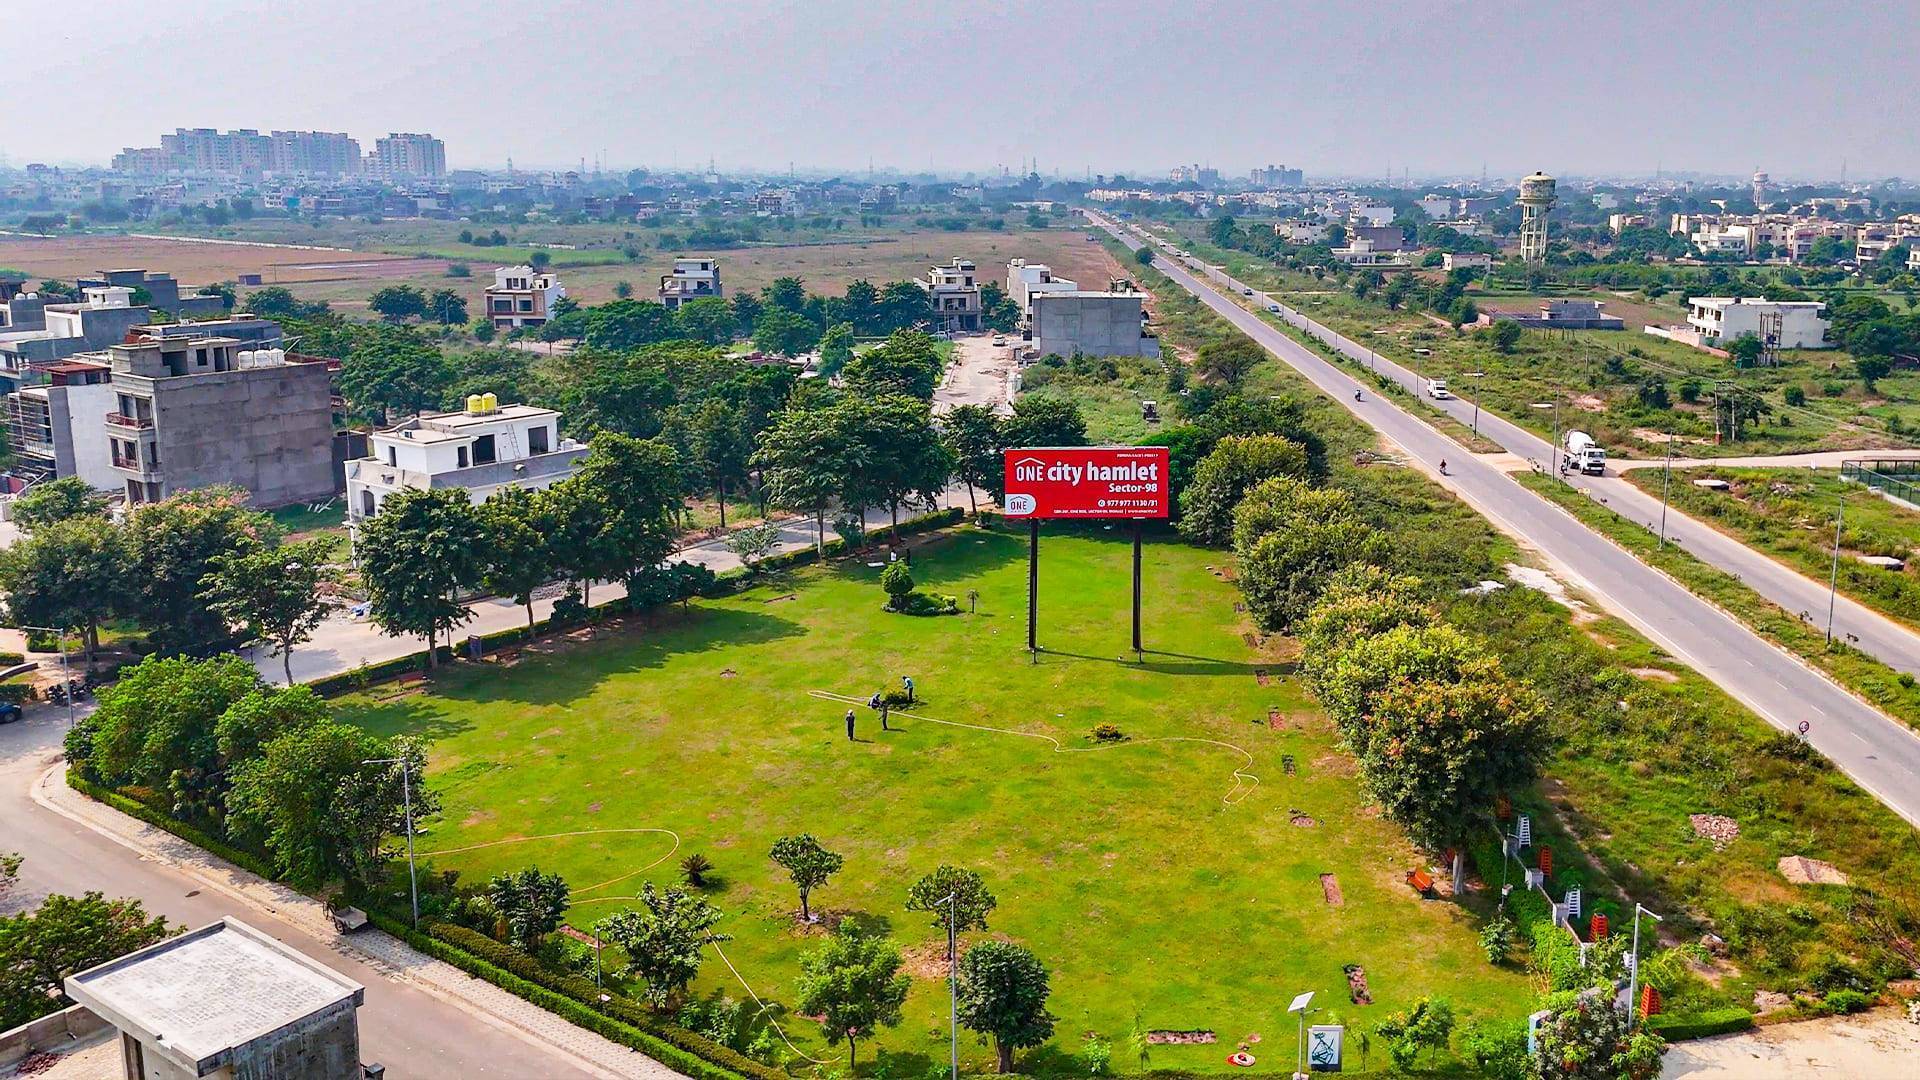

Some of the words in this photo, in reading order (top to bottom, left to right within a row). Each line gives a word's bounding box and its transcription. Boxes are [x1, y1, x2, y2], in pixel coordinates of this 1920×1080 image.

[1016, 466, 1043, 482] ONE
[1047, 461, 1083, 487] city
[1087, 461, 1158, 481] hamlet
[1108, 483, 1158, 493] Sector-98
[1010, 501, 1027, 510] ONE
